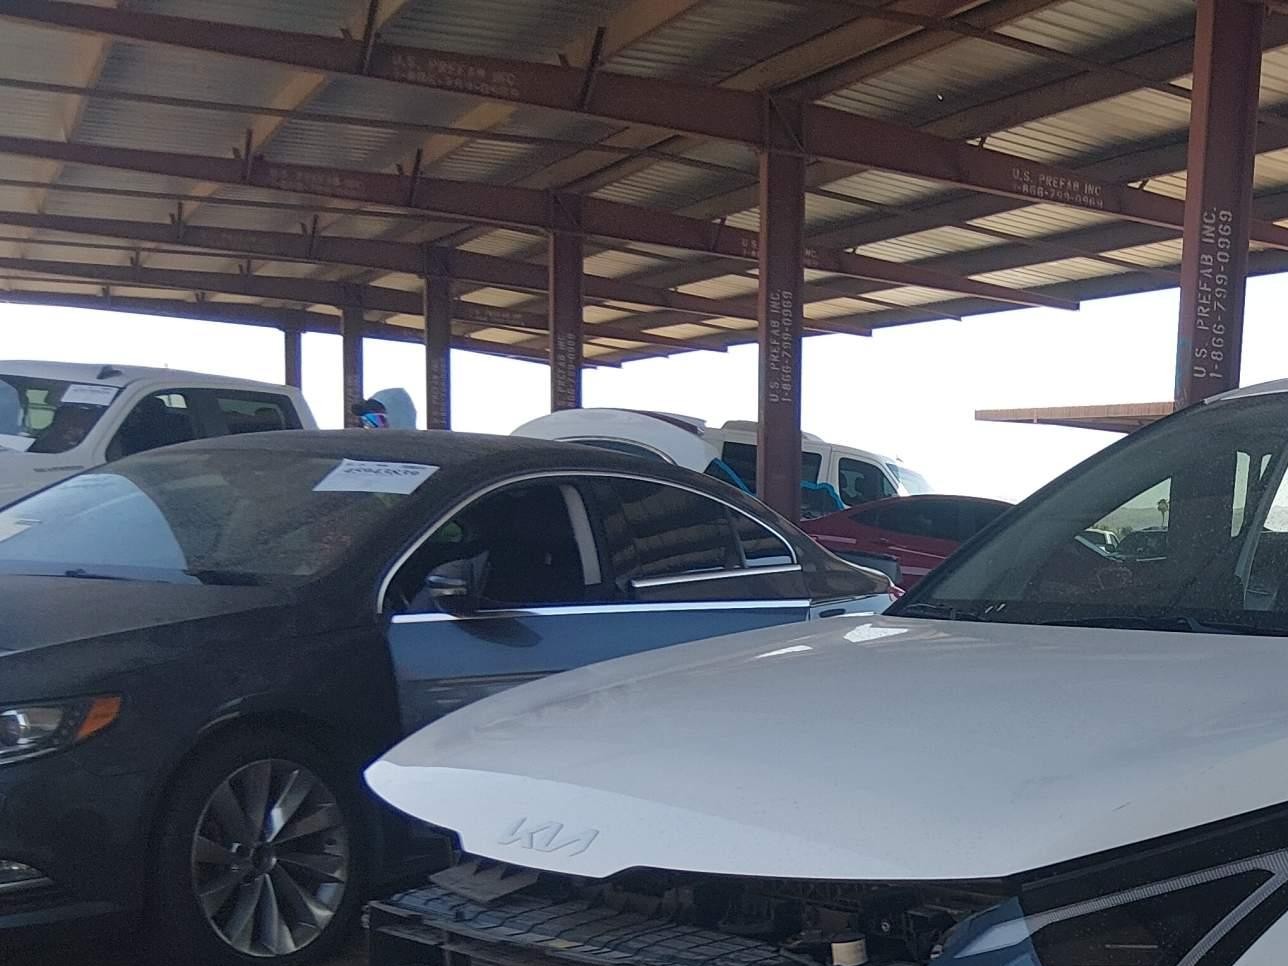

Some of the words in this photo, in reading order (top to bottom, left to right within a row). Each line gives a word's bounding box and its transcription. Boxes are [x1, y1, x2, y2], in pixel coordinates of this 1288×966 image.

[1040, 173, 1079, 191] PREFAB
[1202, 207, 1217, 244] INC.
[1196, 253, 1214, 330] PREFAB
[1209, 209, 1233, 378] 1-866-799-0969
[770, 319, 781, 371] PREFAB
[497, 817, 600, 857] KIA
